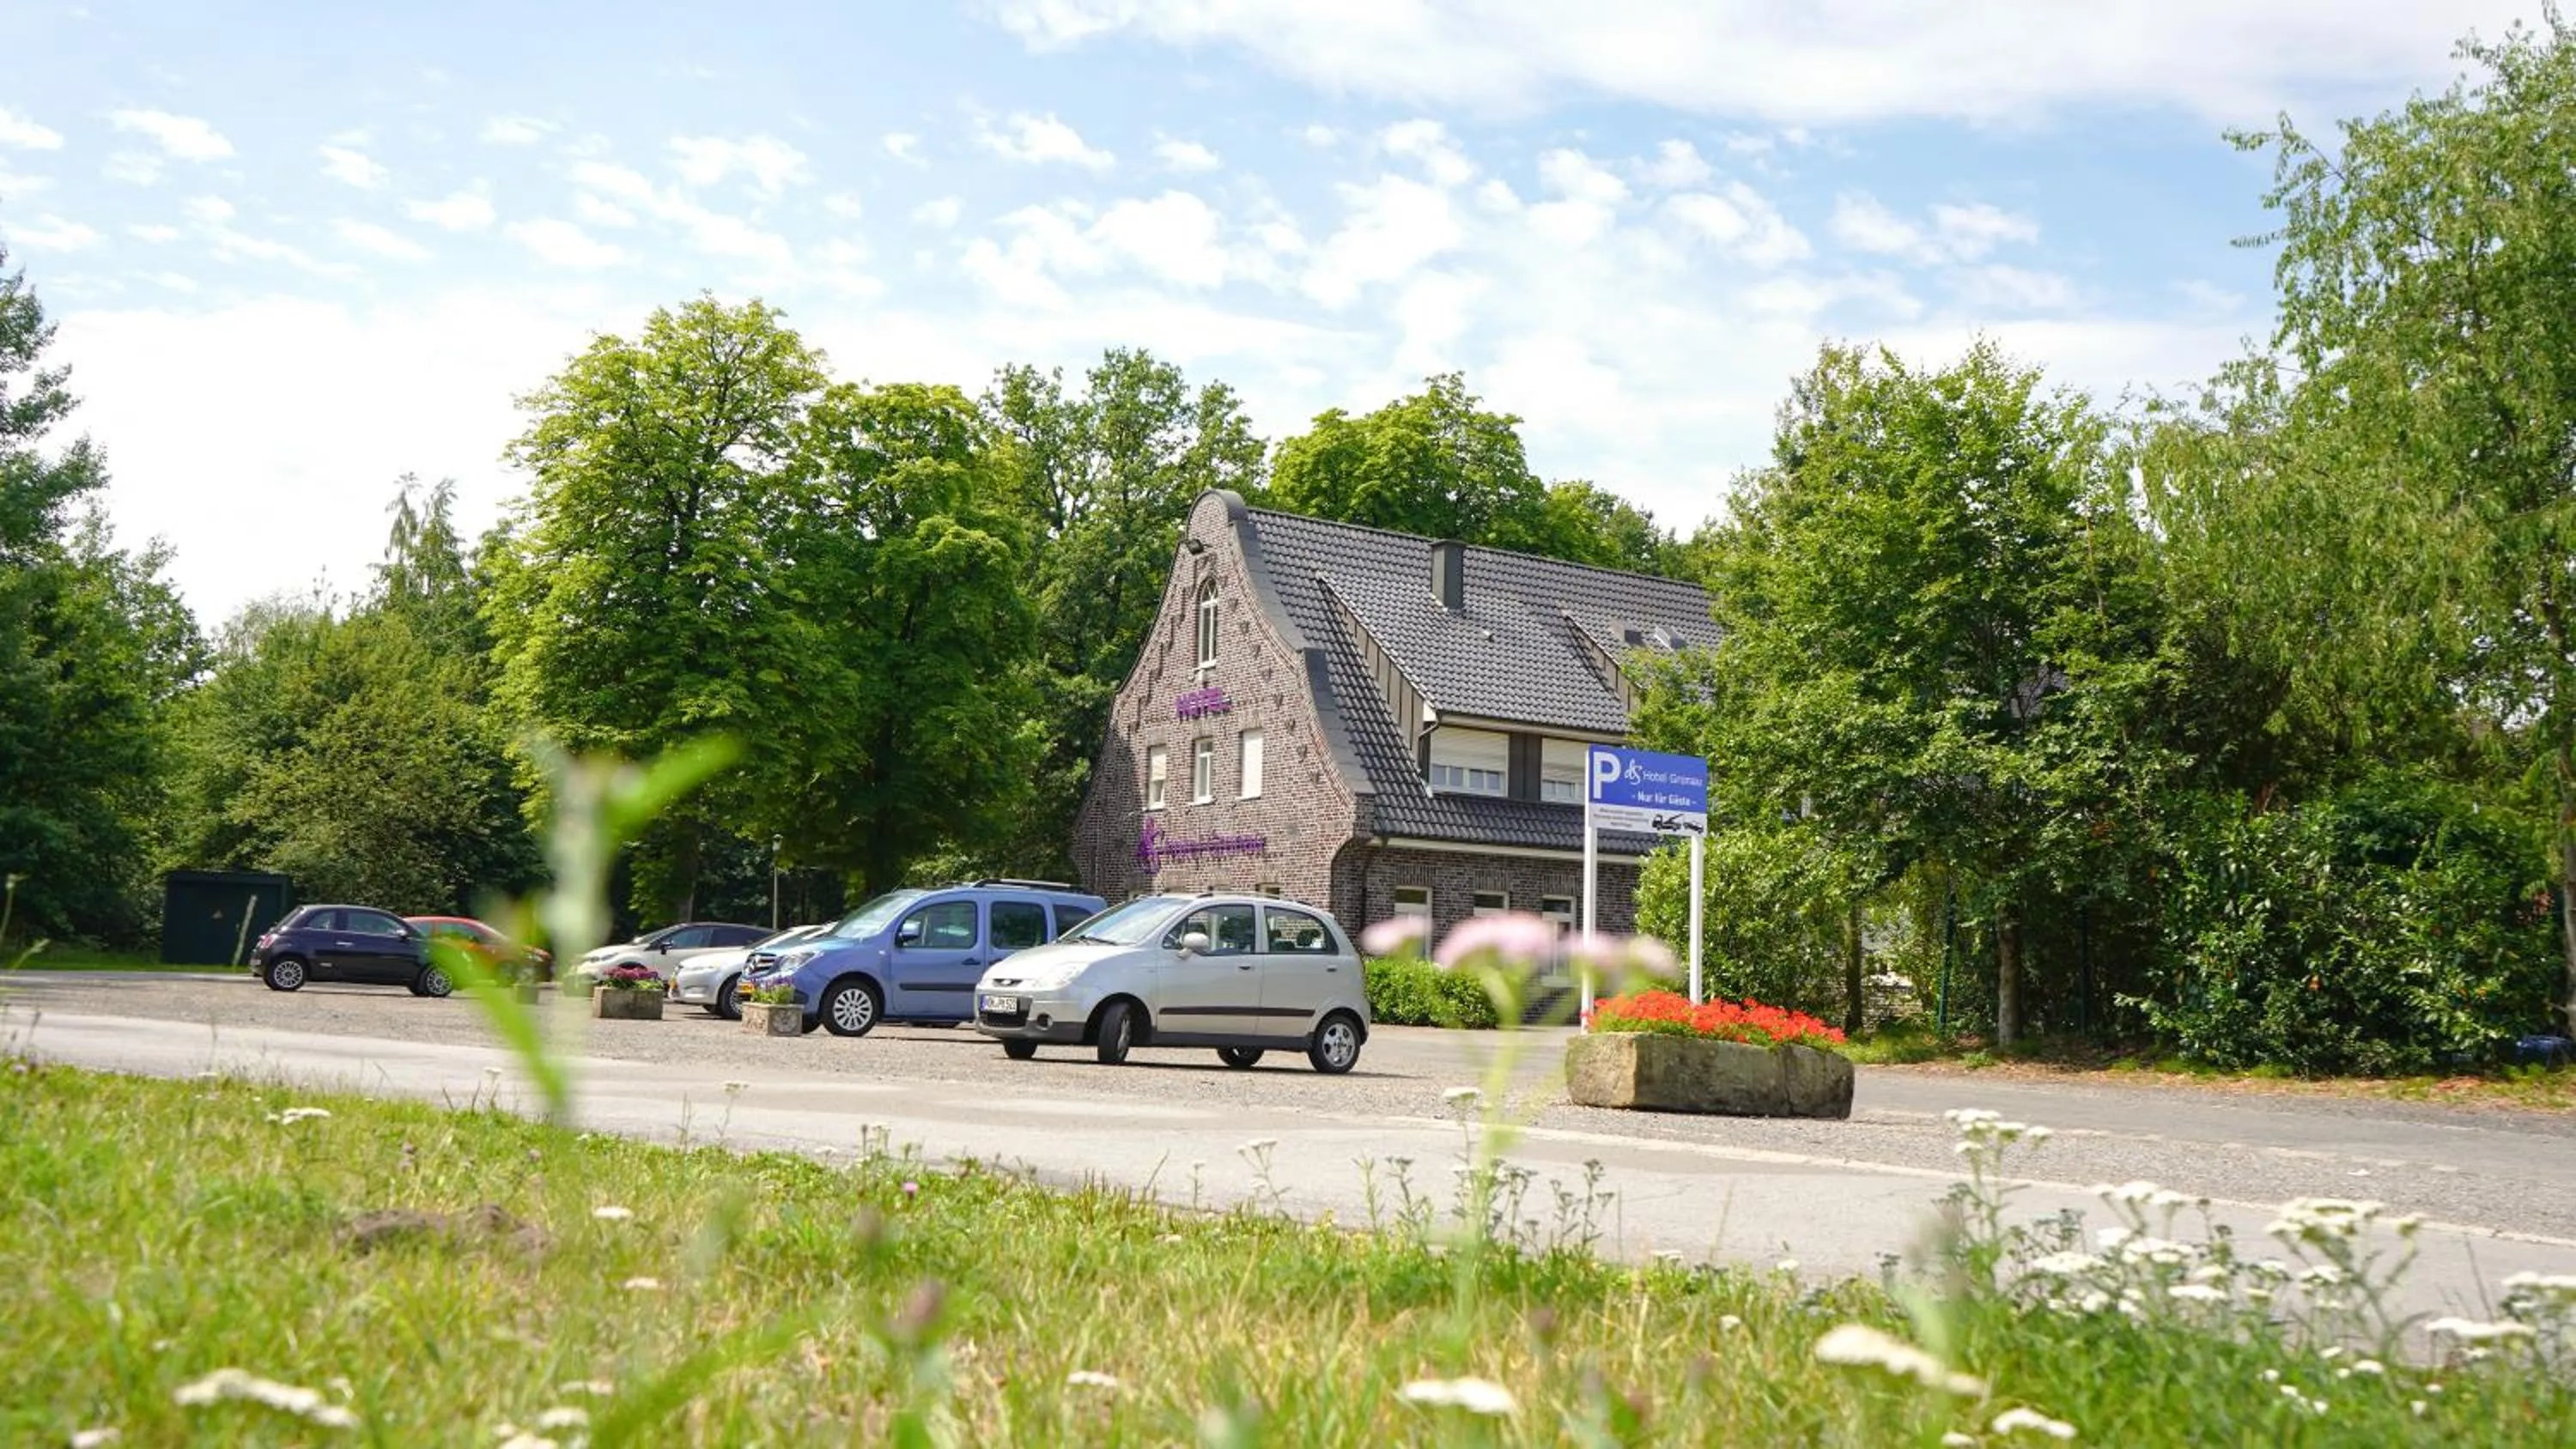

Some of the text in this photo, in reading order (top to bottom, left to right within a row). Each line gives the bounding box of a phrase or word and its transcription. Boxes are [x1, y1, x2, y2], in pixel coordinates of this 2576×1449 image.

[1593, 752, 1621, 799] P
[1643, 770, 1667, 783] Hotel
[1637, 790, 1652, 803] Nur
